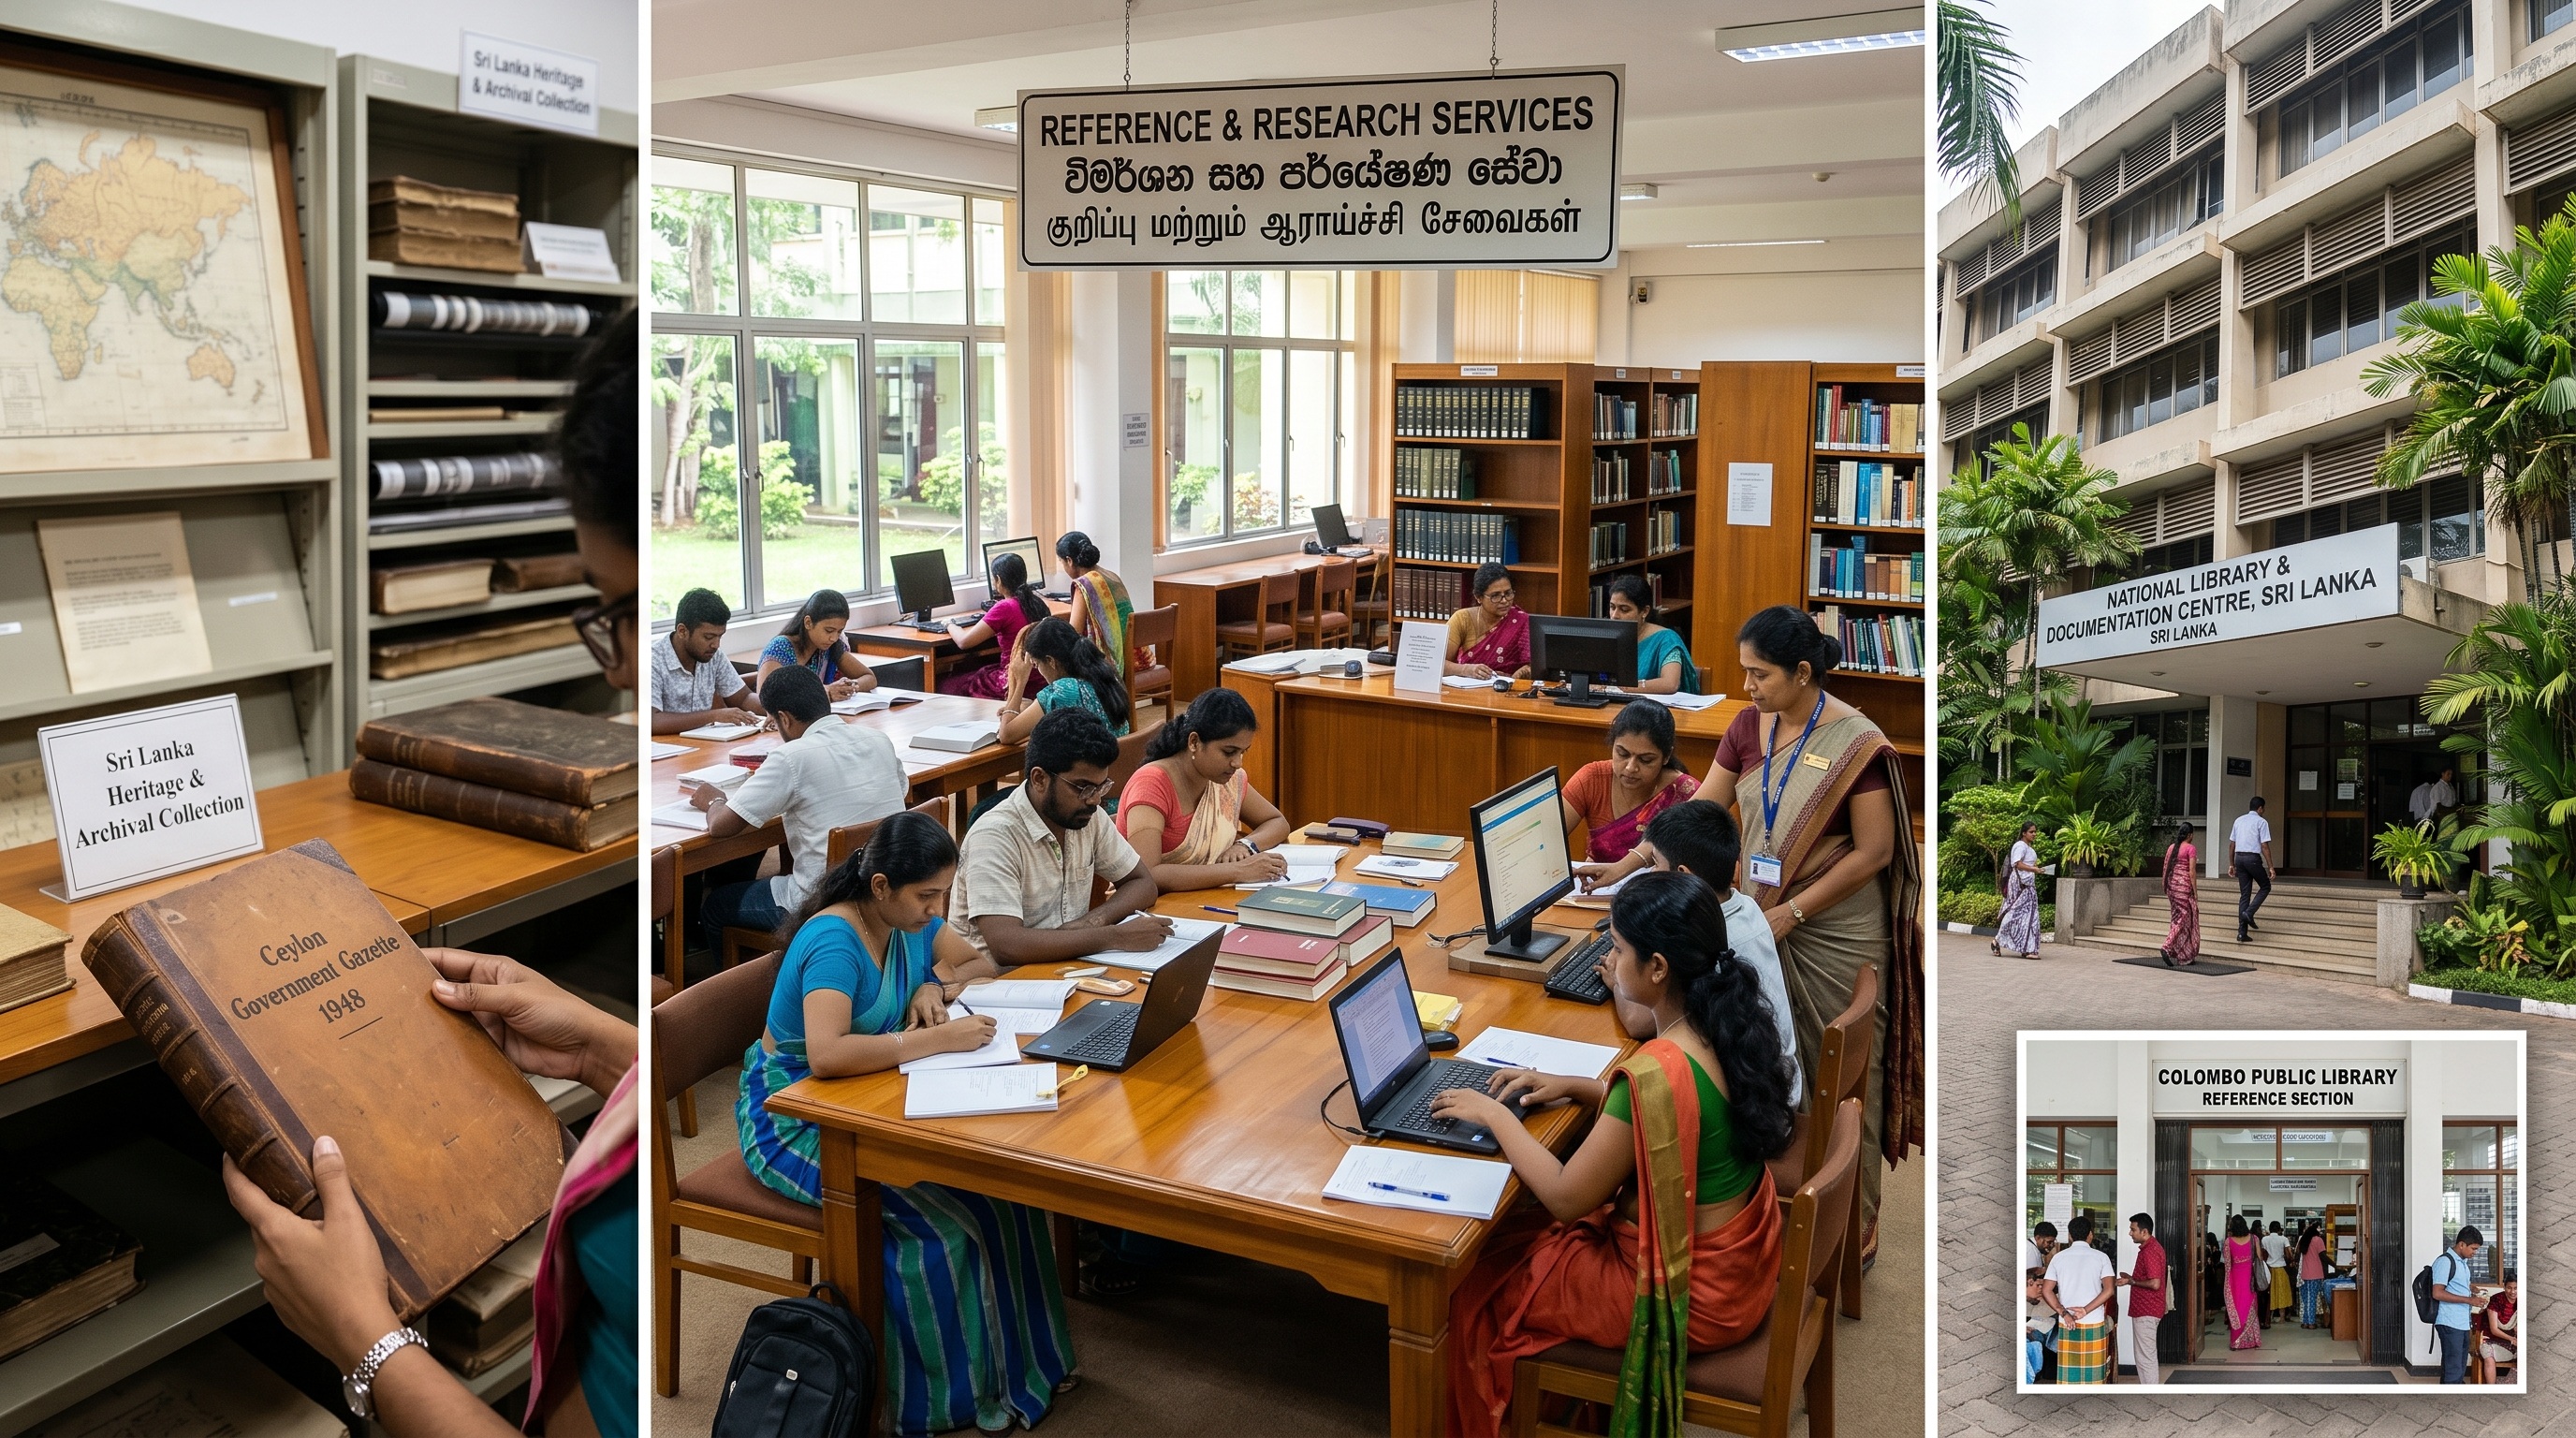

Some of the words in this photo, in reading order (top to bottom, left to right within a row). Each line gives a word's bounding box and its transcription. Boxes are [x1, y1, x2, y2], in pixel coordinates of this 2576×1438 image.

[474, 51, 491, 69] Sri
[495, 54, 531, 78] Lanka
[534, 65, 585, 92] Heritage
[472, 76, 482, 95] &
[485, 80, 533, 105] Archival
[536, 91, 591, 115] Collection
[1042, 110, 1211, 146] REFERENCE
[1222, 109, 1243, 141] &
[1254, 102, 1420, 139] RESEARCH
[1432, 96, 1594, 135] SERVICES
[1065, 156, 1194, 194] විමර්ශන
[1208, 163, 1265, 191] සහ
[1280, 149, 1451, 190] පර්යේෂණ
[1468, 145, 1563, 185] සේවා
[1047, 205, 1136, 247] குறிப்பு
[1151, 204, 1247, 247] மற்றும்
[1260, 200, 1404, 246] ஆராய்ச்சி
[1421, 198, 1582, 235] சேவைகள்
[2107, 578, 2185, 609] NATIONAL
[2191, 559, 2271, 592] LIBRARY
[2277, 555, 2291, 576] &
[2047, 605, 2173, 644] DOCUMENTATION
[2177, 590, 2256, 622] CENTRE,
[2261, 582, 2294, 607] SRI
[2302, 568, 2377, 600] LANKA
[2150, 628, 2170, 645] SRI
[2174, 623, 2217, 641] LANKA
[106, 749, 134, 773] Sri
[138, 740, 195, 766] Lanka
[107, 777, 184, 807] Heritage
[189, 768, 205, 788] &
[76, 813, 155, 849] Archival
[159, 796, 244, 829] Collection
[259, 932, 329, 966] Ceylon
[230, 960, 341, 1020] Government
[338, 935, 401, 971] Gazette
[318, 988, 366, 1024] 1948
[2159, 1068, 2246, 1085] COLOMBO
[2251, 1068, 2316, 1085] PUBLIC
[2321, 1068, 2398, 1085] LIBRARY
[2203, 1092, 2287, 1106] REFERENCE
[2291, 1092, 2354, 1106] SECTION
